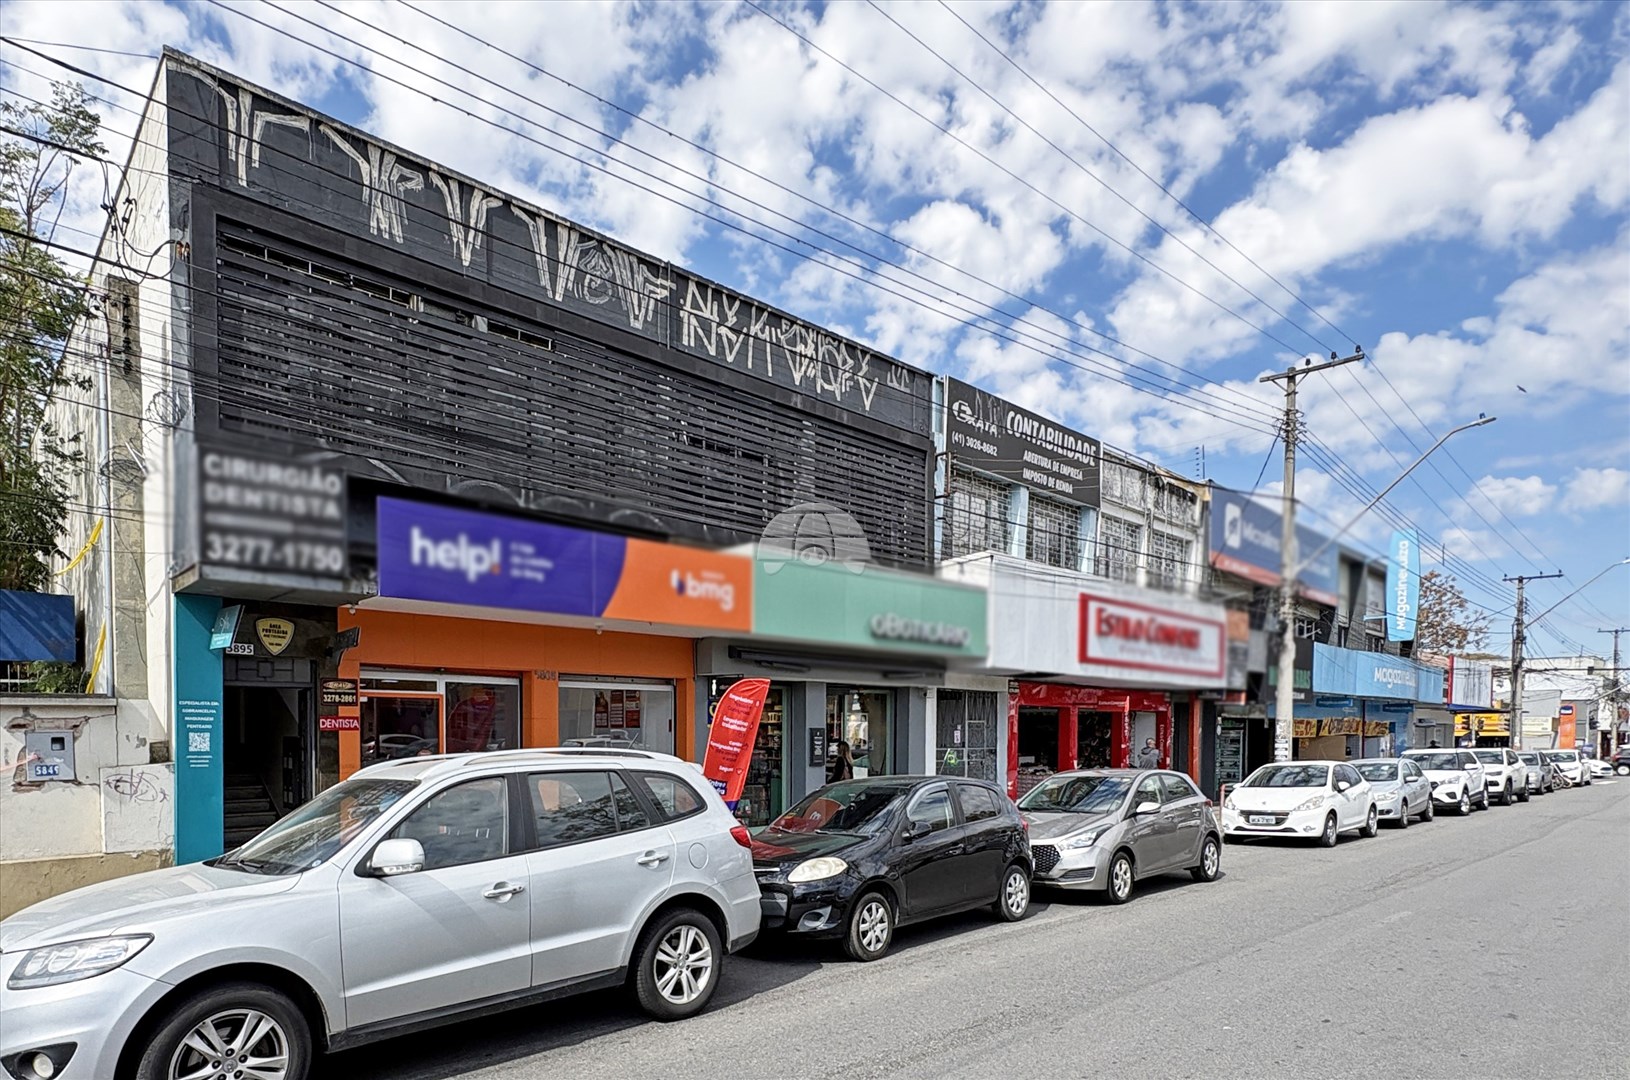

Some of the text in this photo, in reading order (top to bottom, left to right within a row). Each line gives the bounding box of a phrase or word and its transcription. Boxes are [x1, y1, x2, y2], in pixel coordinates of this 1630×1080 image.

[1006, 410, 1097, 467] CONTABILIDADE
[1023, 450, 1083, 481] ABERTURA DE EMPRESA
[1023, 467, 1047, 486] IMPOSTO
[1055, 478, 1073, 495] RENDA
[204, 481, 342, 521] DENTISTA
[411, 526, 502, 583] help!
[686, 571, 735, 612] bmg
[320, 718, 360, 729] DENTISTA
